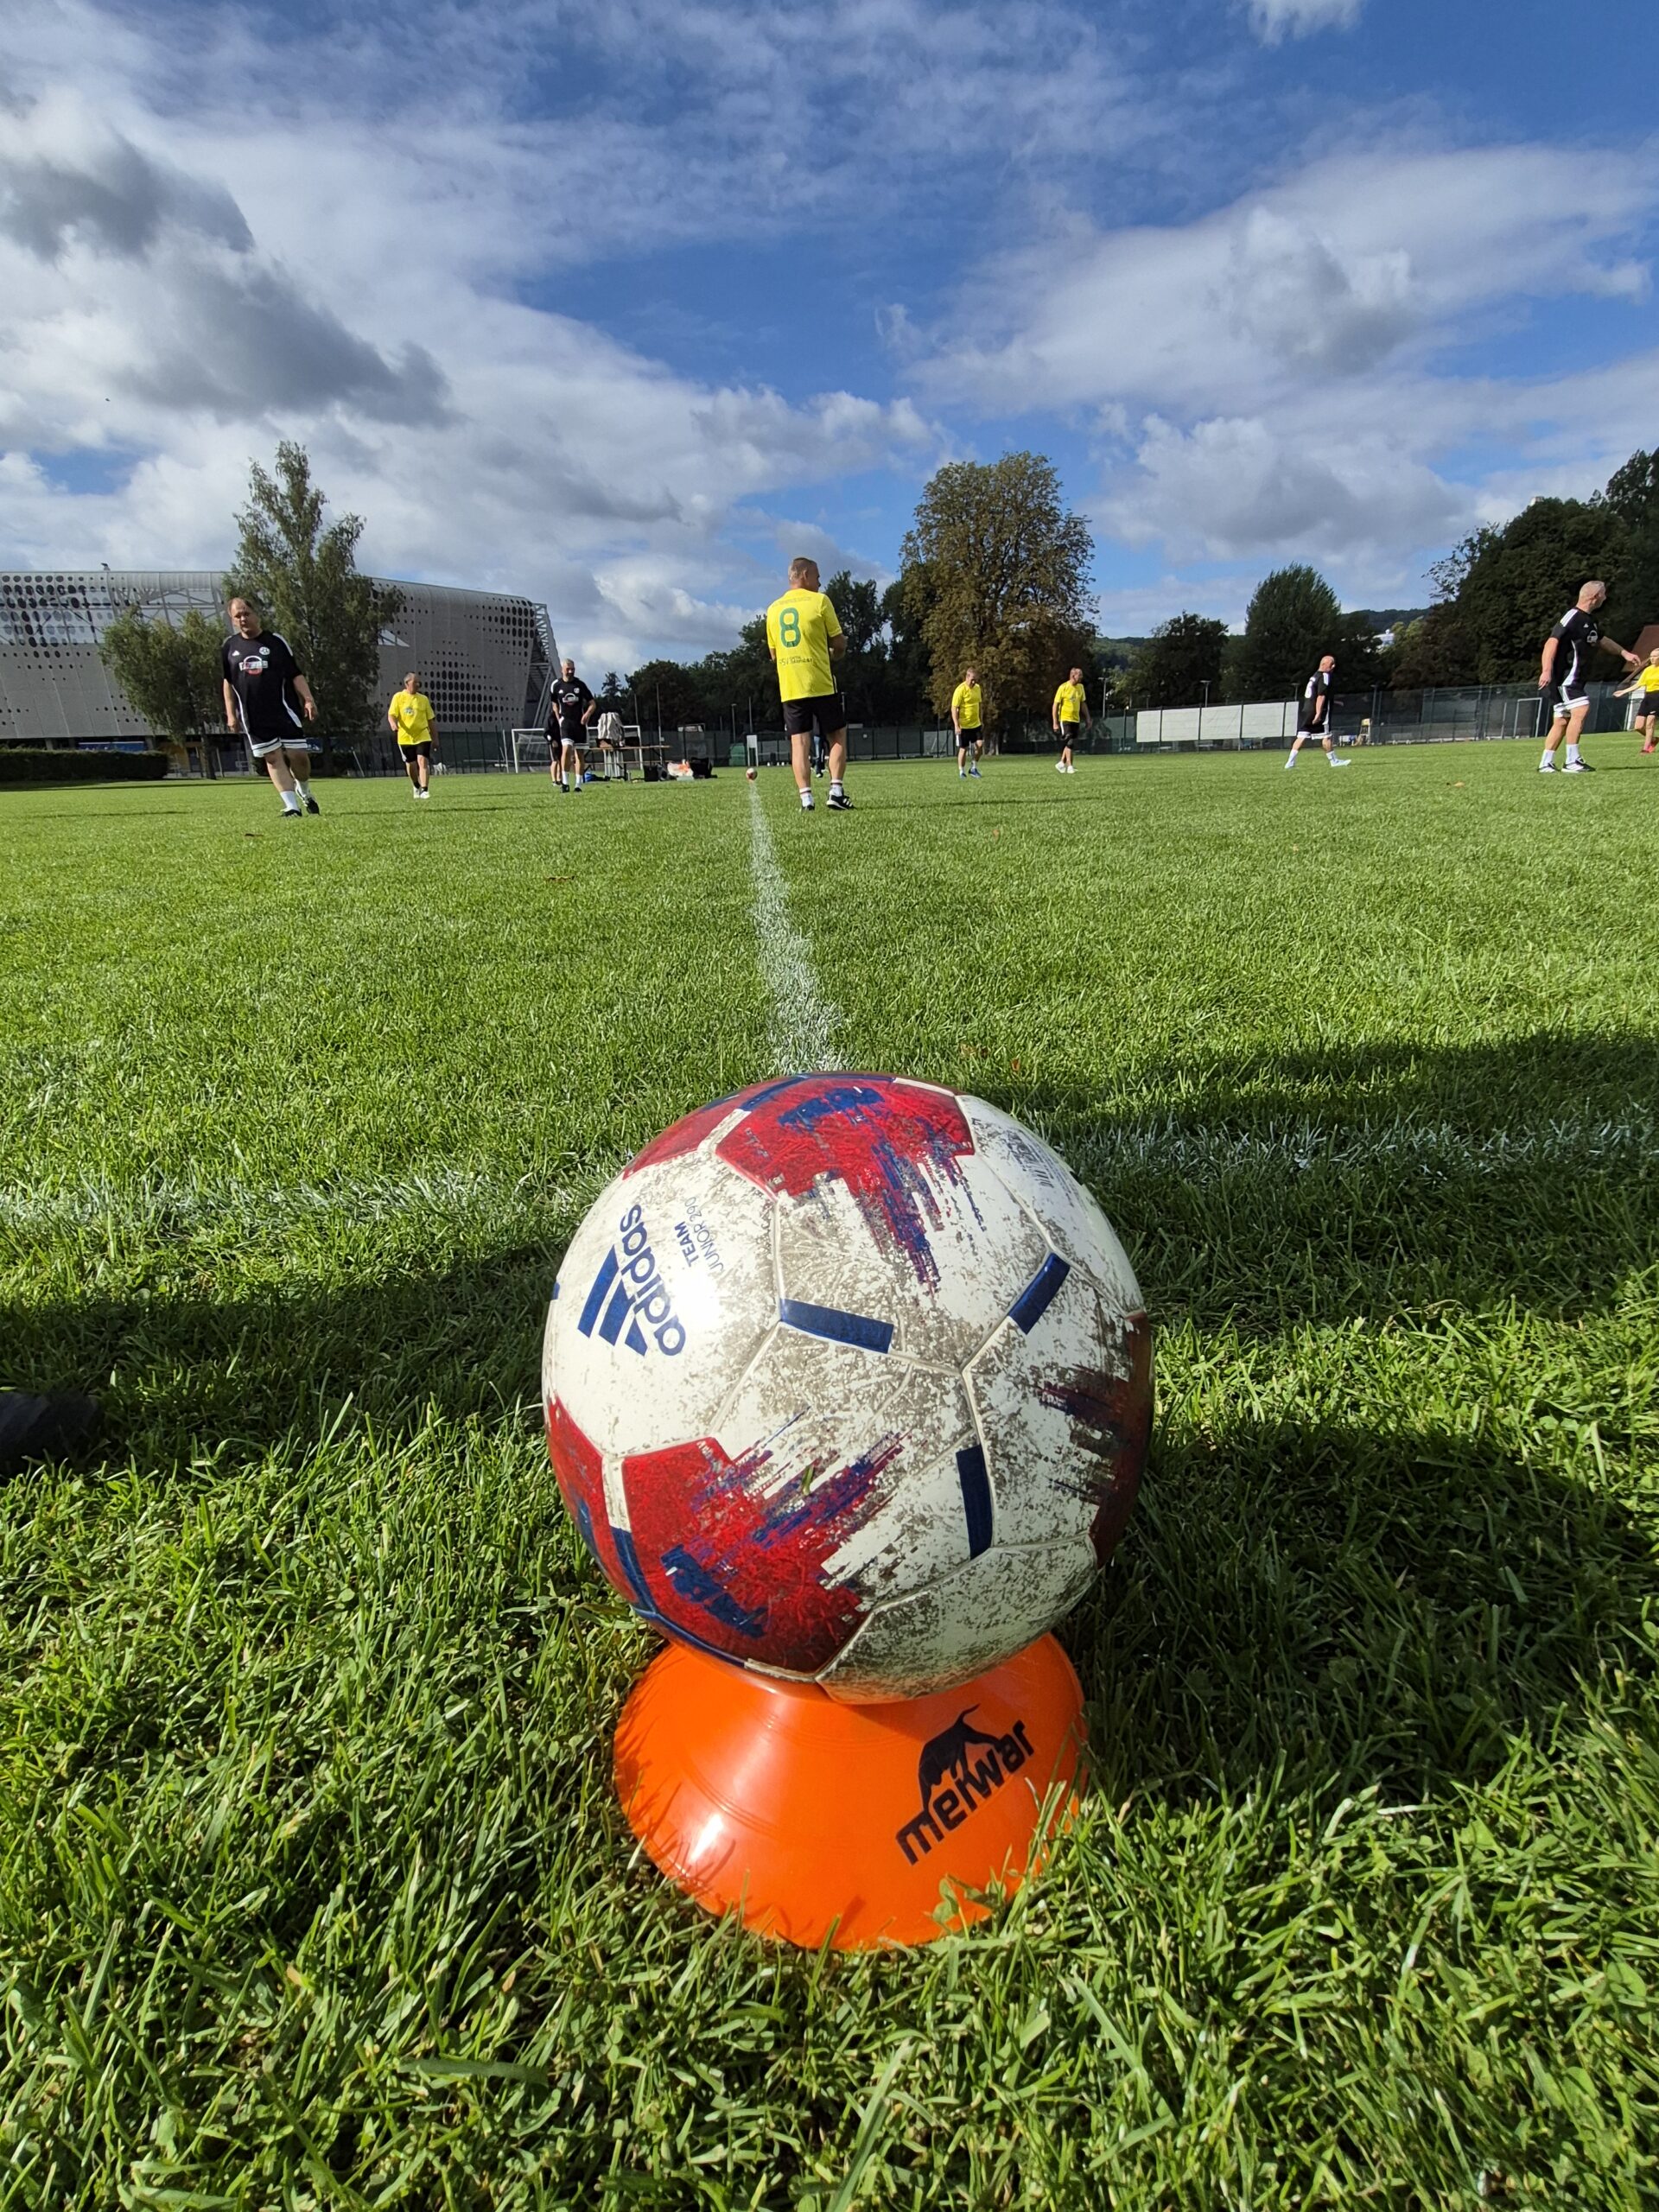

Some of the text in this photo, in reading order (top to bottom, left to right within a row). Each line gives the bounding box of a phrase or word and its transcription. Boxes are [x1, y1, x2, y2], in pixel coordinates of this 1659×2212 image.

[779, 607, 801, 648] 8
[674, 1221, 700, 1268] TEAM
[684, 1196, 724, 1274] JUNIOR 290
[620, 1204, 686, 1357] adidas
